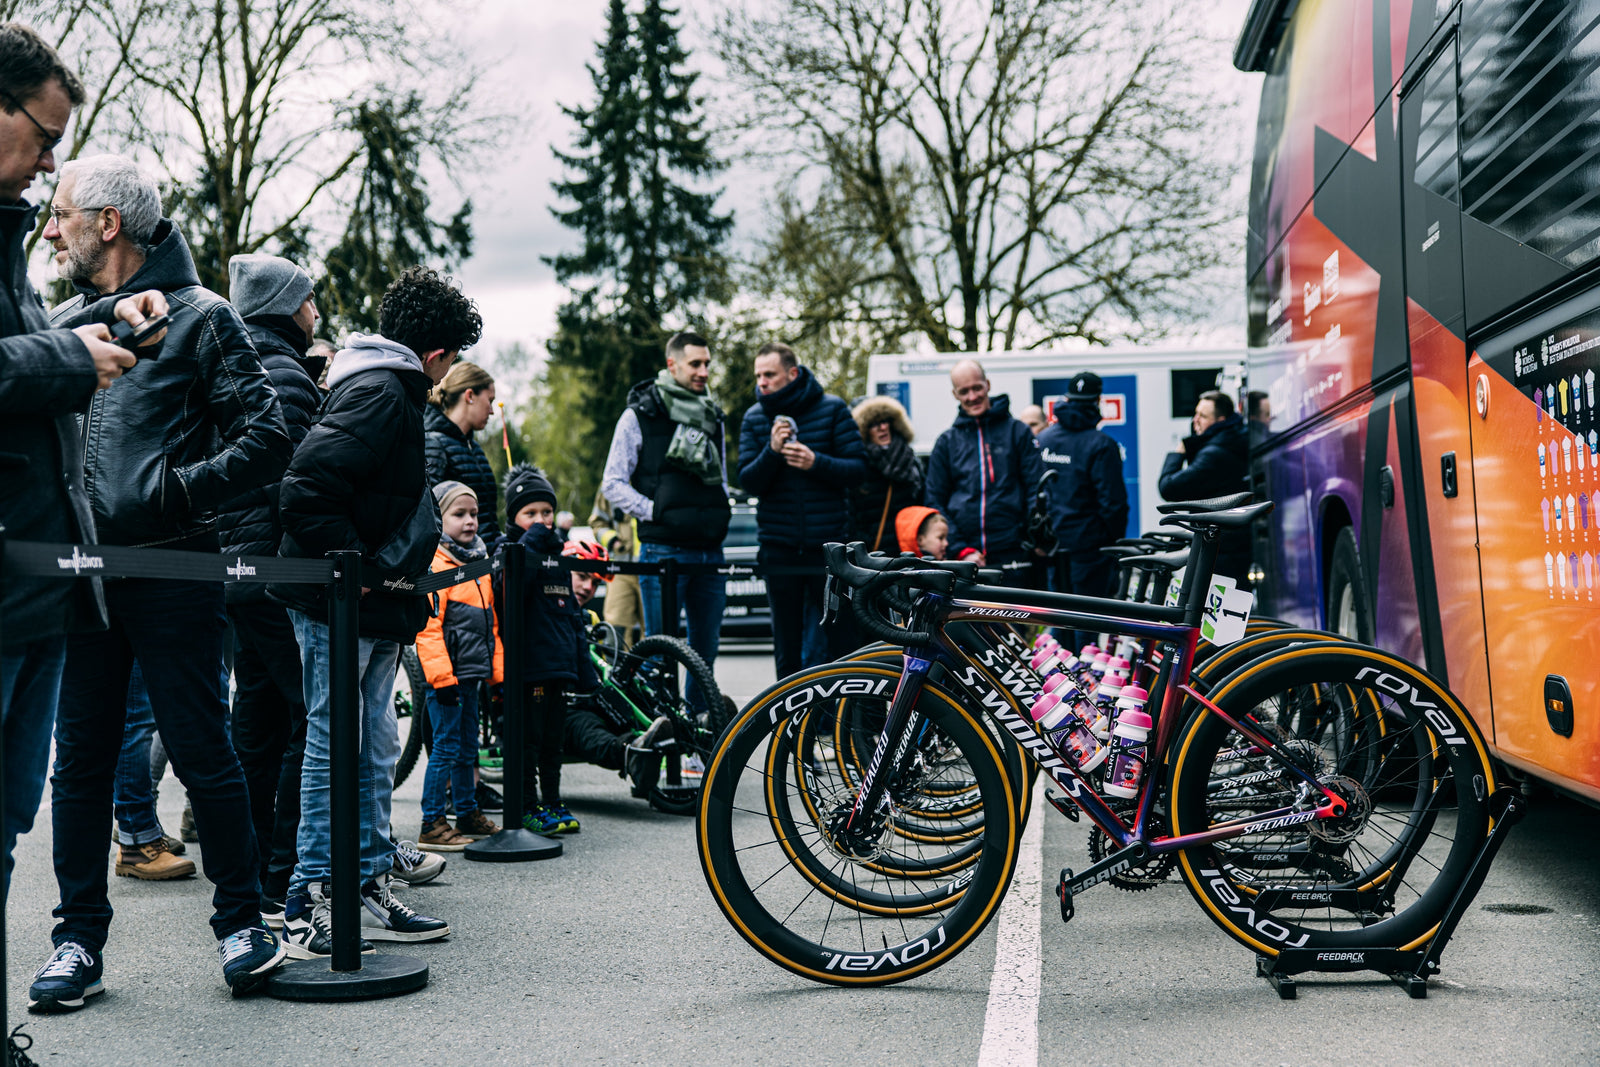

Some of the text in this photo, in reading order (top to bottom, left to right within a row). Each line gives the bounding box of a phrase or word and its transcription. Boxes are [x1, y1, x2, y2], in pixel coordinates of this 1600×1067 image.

[965, 606, 1031, 619] SPECIALIZED
[1222, 608, 1248, 622] 1
[769, 679, 889, 724] roval
[1355, 667, 1467, 745] roval
[953, 665, 1093, 799] S-WORKS
[856, 730, 889, 815] SPECIALIZED
[1106, 738, 1118, 779] GARMN
[1241, 812, 1315, 835] SPECIALIZED
[1072, 859, 1130, 895] SRAM
[1200, 869, 1310, 948] roval
[825, 926, 947, 971] roval
[1317, 952, 1364, 961] FEEDBACK
